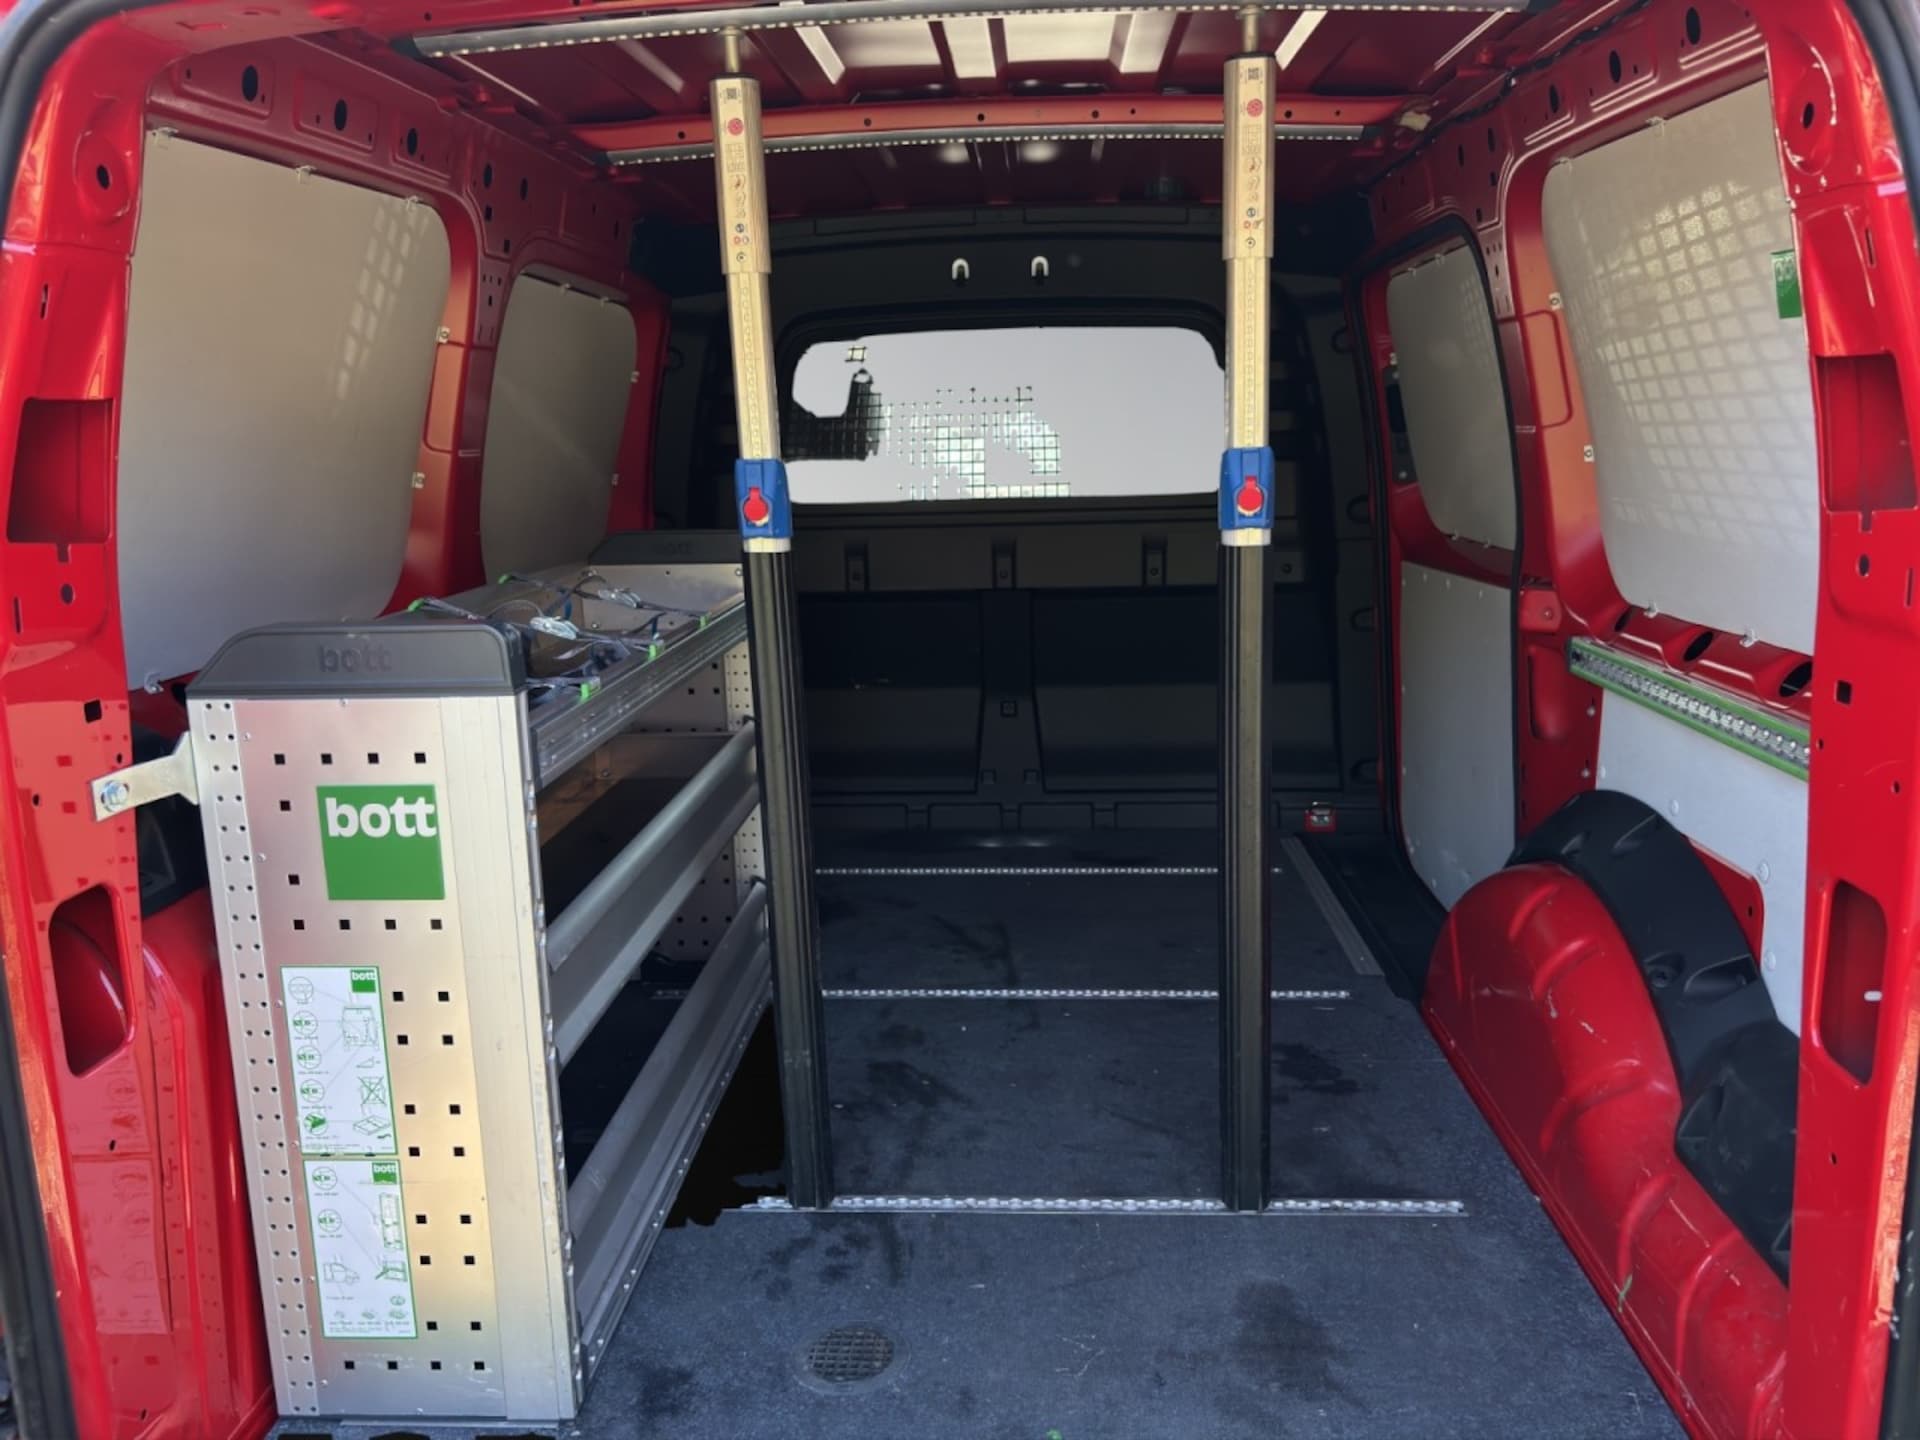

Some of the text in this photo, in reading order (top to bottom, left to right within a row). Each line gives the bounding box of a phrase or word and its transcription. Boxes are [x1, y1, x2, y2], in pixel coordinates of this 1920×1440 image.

[320, 643, 393, 673] bott
[325, 796, 437, 838] bott
[351, 971, 376, 981] bott
[373, 1164, 397, 1174] bott
